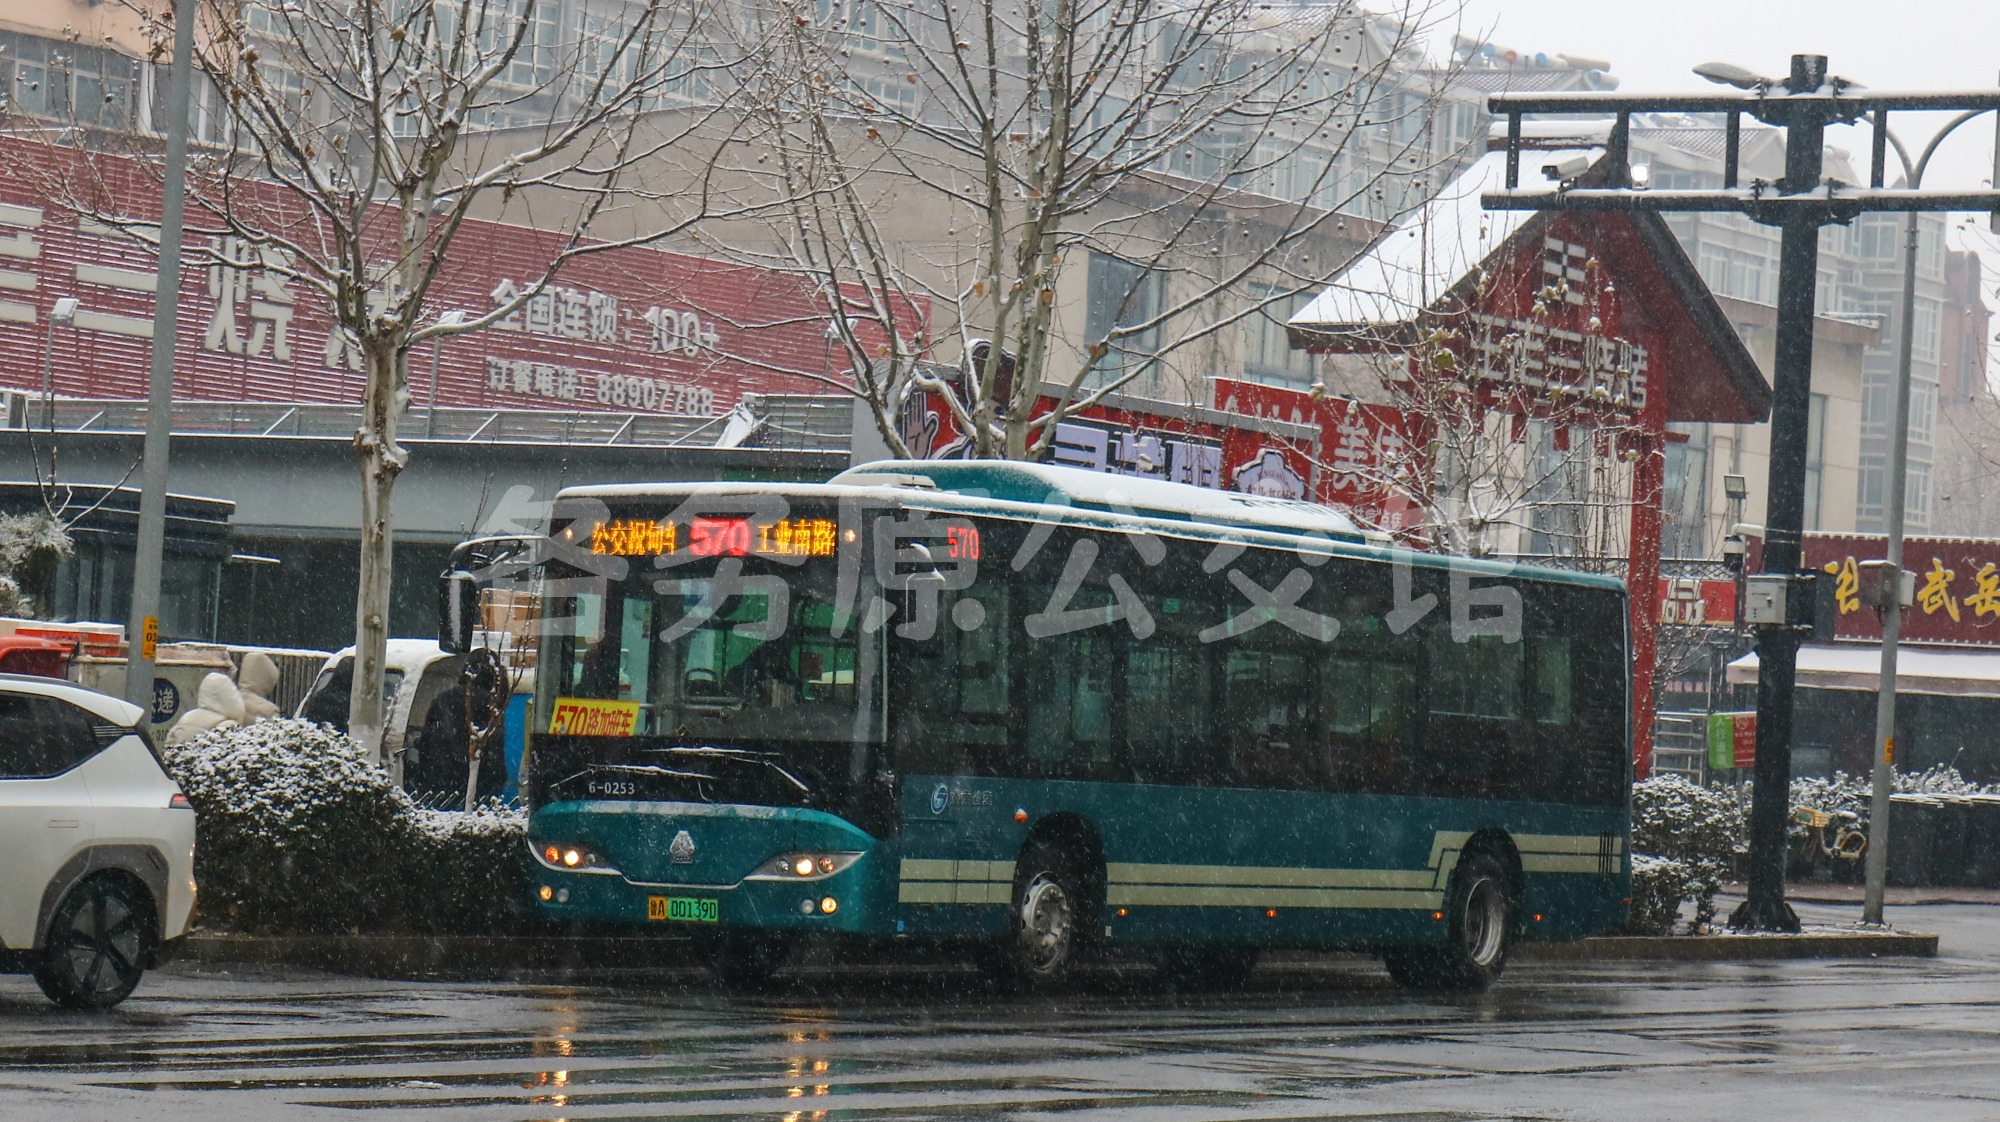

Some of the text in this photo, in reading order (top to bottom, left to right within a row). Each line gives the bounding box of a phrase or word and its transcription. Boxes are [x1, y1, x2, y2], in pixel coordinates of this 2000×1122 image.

[692, 519, 750, 556] 570
[948, 527, 981, 560] 570
[588, 782, 635, 795] 6-0253
